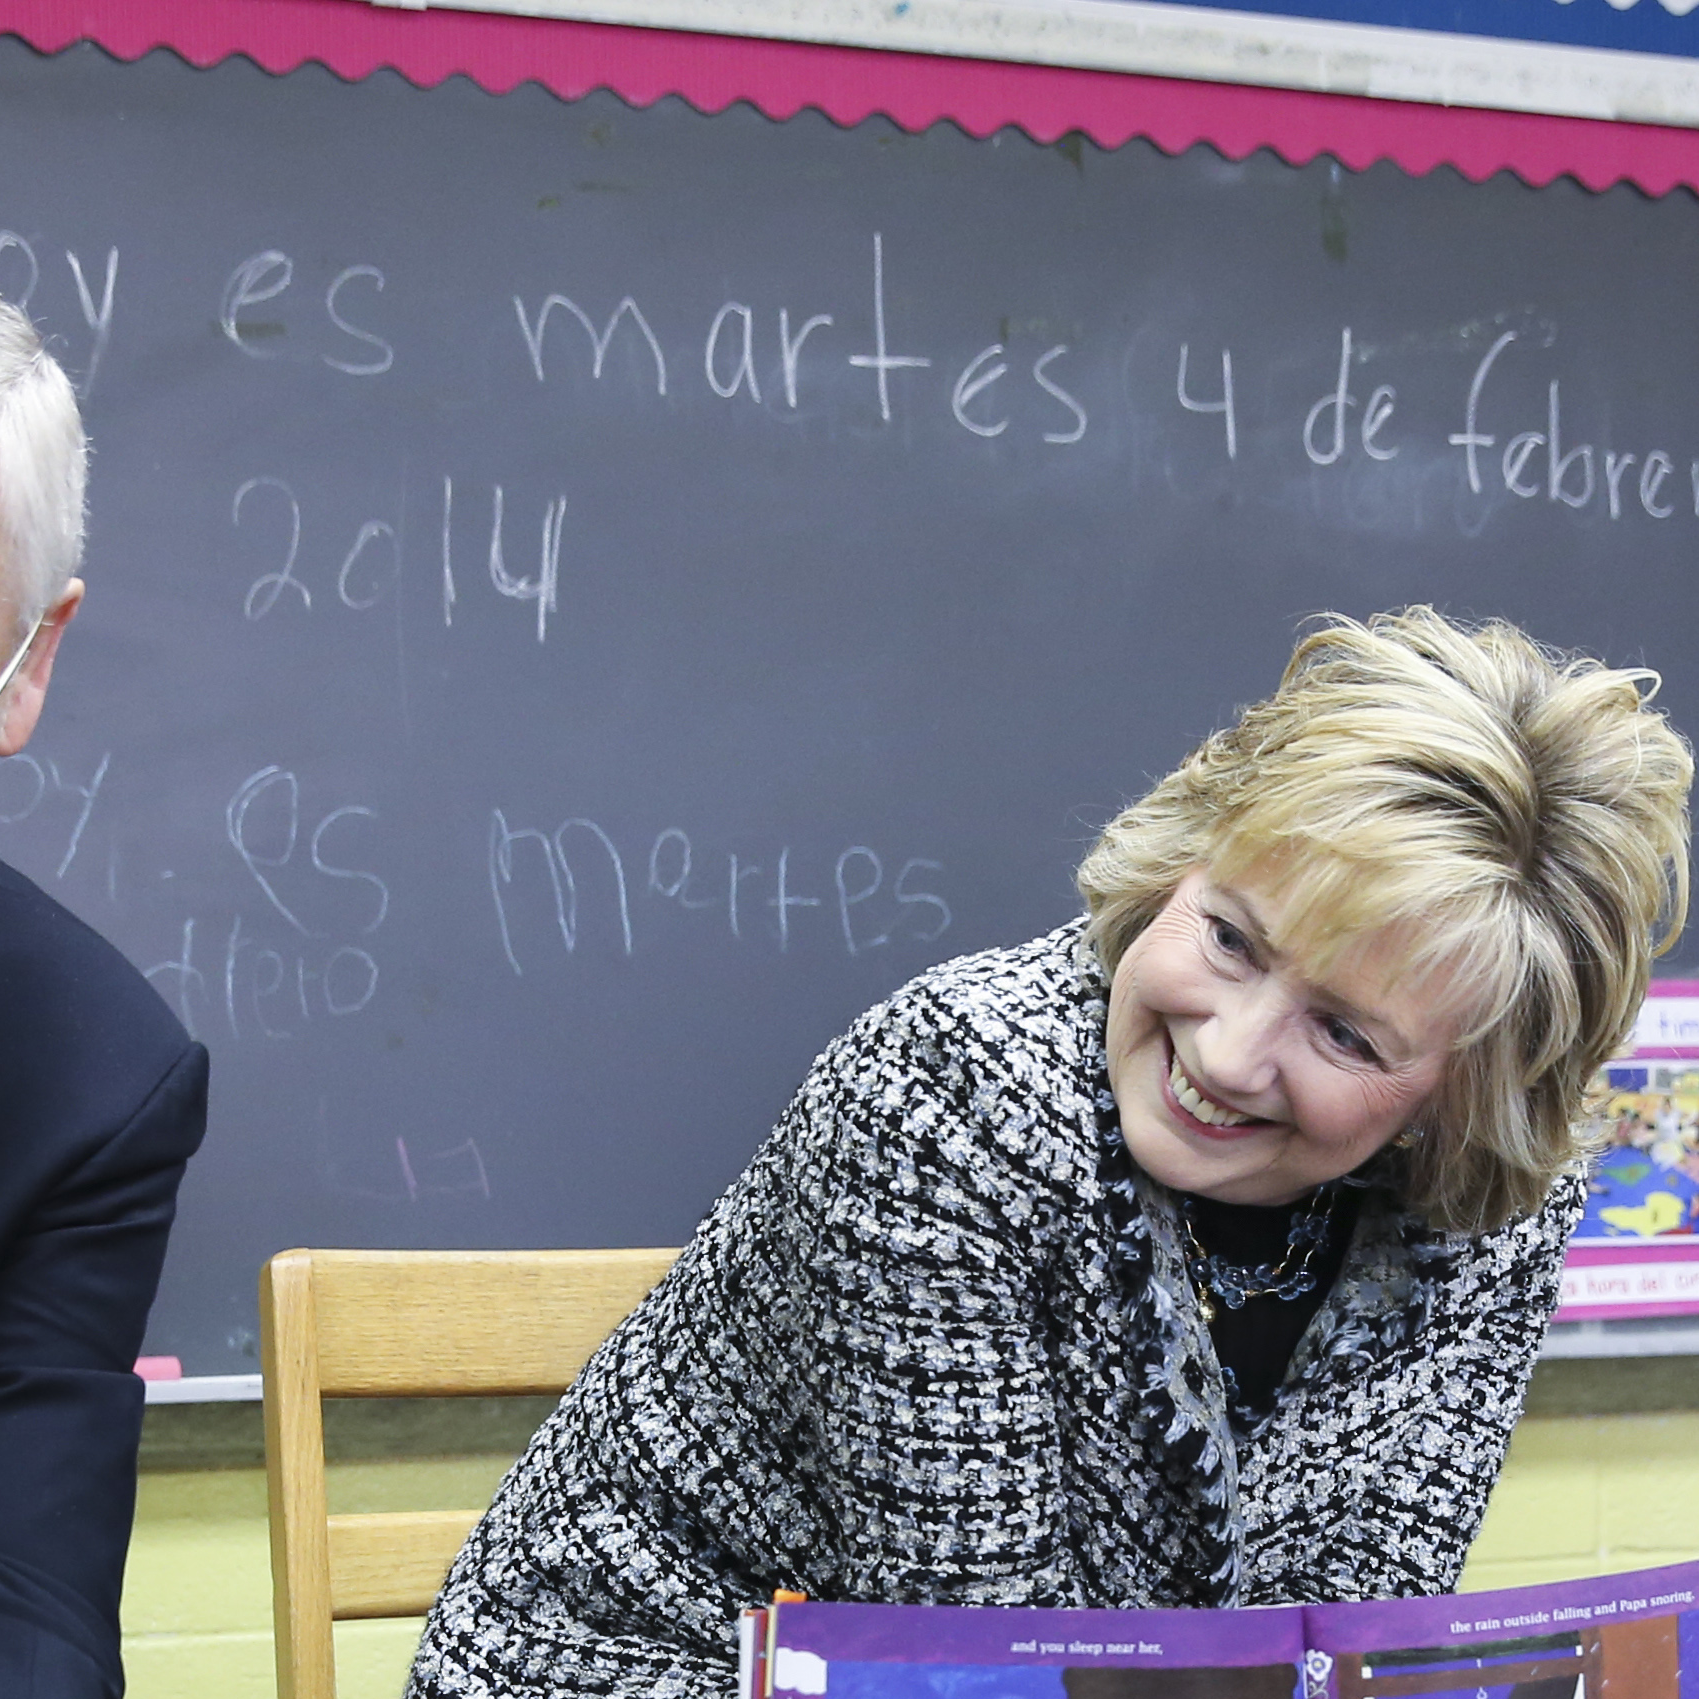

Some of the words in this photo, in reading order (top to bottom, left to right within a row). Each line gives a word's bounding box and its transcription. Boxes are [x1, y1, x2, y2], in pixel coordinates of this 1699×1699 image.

[221, 250, 394, 376] es
[514, 231, 1089, 443] martes
[1177, 343, 1237, 460] 4
[1304, 327, 1398, 466] de
[233, 476, 566, 642] 2014
[1010, 1639, 1037, 1653] and
[1039, 1643, 1066, 1656] you
[1068, 1640, 1103, 1657] sleep
[1105, 1643, 1136, 1653] near
[1450, 1620, 1473, 1634] the
[1475, 1616, 1501, 1632] rain
[1503, 1610, 1551, 1629] outside
[1553, 1603, 1592, 1622] falling
[1594, 1600, 1617, 1616] and
[1650, 1588, 1696, 1609] snoring.
